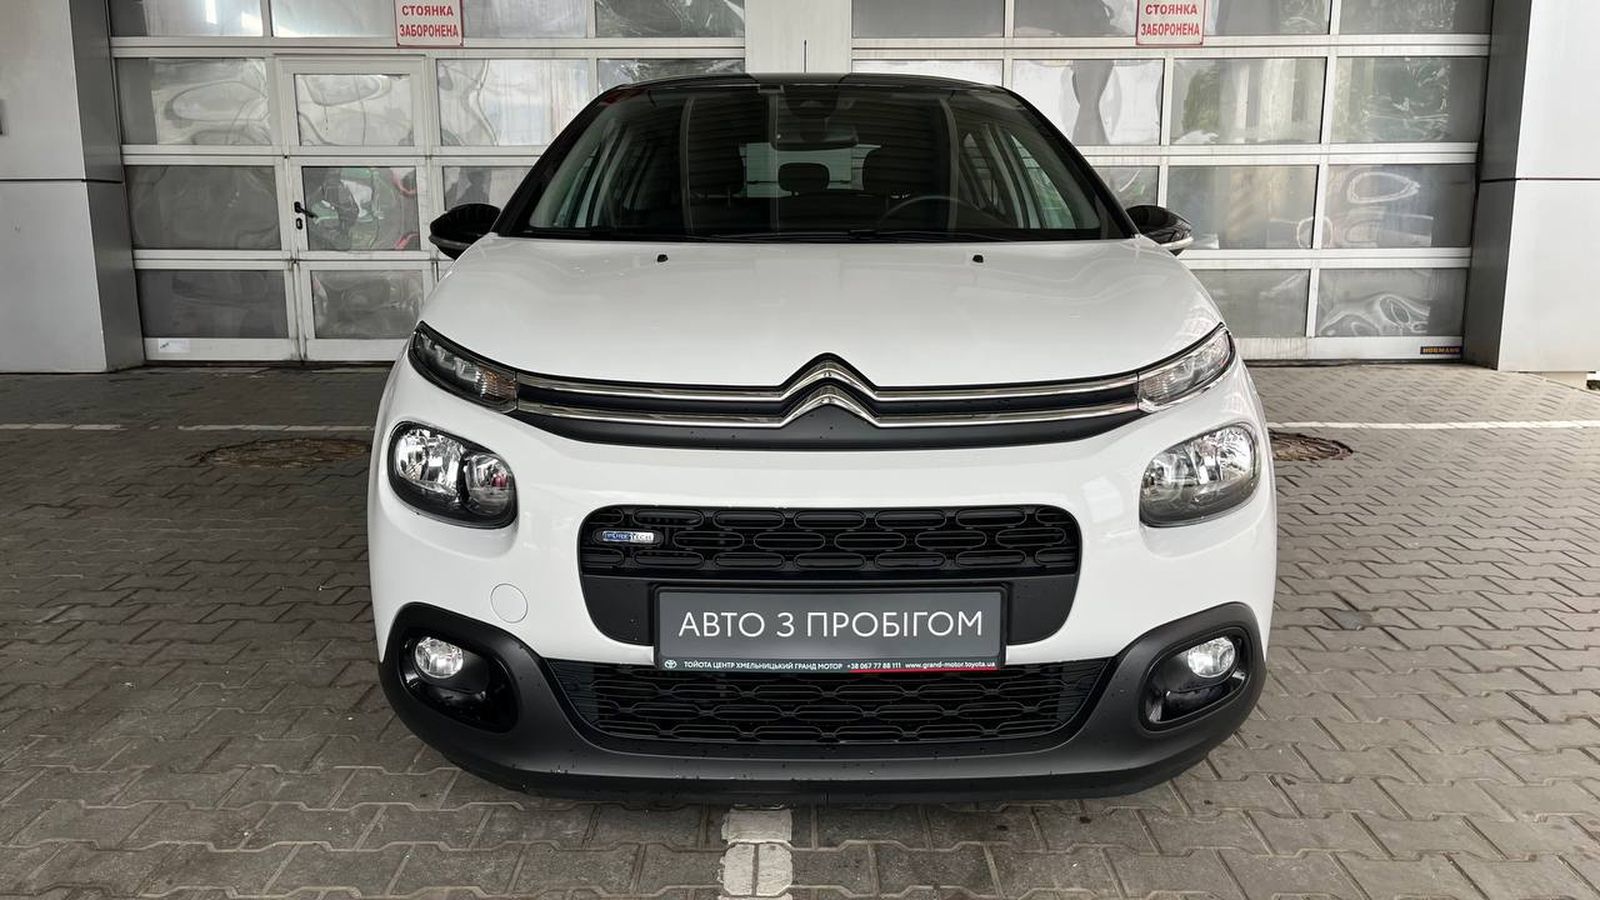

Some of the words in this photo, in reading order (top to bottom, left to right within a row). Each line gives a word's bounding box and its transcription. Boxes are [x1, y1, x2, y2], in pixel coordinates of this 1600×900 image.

[401, 5, 454, 16] СТОЯНКА
[1145, 4, 1198, 15] СТОЯНКА
[399, 24, 459, 37] ЗАБОРОНЕНА
[1140, 23, 1200, 36] ЗАБОРОНЕНА
[678, 611, 765, 637] АВТО
[807, 610, 983, 637] ПРОБІГОМ
[684, 659, 712, 668] ТОЙОТА
[713, 661, 735, 669] ЦЕНТР
[794, 662, 817, 671] ГРАНД
